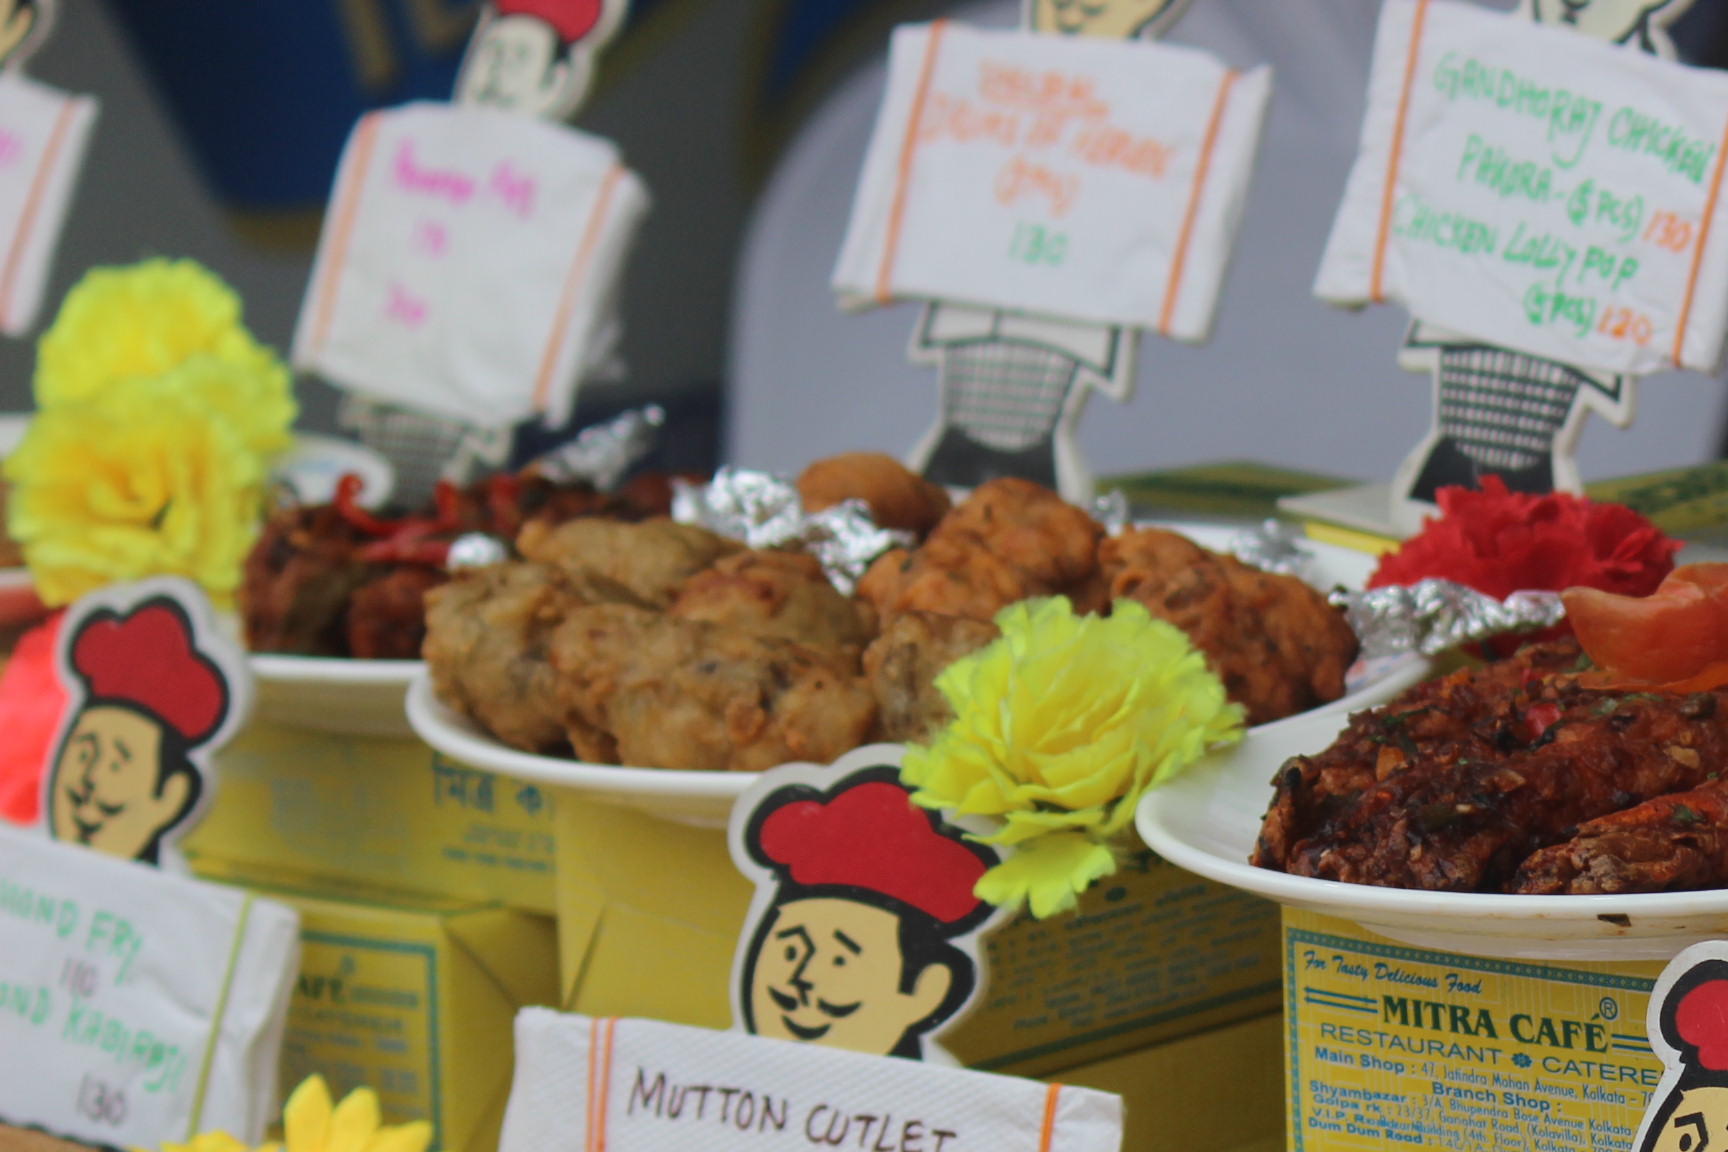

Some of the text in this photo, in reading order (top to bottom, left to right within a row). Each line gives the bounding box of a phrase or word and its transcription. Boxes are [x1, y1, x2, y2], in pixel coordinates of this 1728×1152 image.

[1607, 106, 1716, 185] CHICKEN
[1303, 949, 1483, 995] For Tasty Delicious Food
[1381, 994, 1609, 1054] MITRA CAFÉ
[1315, 1046, 1355, 1066] Main
[1360, 1054, 1406, 1075] Shop
[1492, 1073, 1530, 1092] Mohan
[1583, 1084, 1626, 1105] Kolkata
[1321, 1022, 1664, 1088] RESTAURANT CATERE
[627, 1066, 788, 1132] MUTTON
[1310, 1080, 1407, 1104] Shyambazar
[1449, 1099, 1509, 1120] Bhupendra
[1513, 1109, 1539, 1124] Bose
[1544, 1112, 1585, 1130] Avenue
[1589, 1118, 1632, 1137] Kolkata
[1432, 1082, 1496, 1103] Branch
[1503, 1091, 1551, 1112] Shop
[1308, 1117, 1342, 1132] Dum
[1346, 1123, 1381, 1138] Dum
[1385, 1128, 1424, 1145] Road
